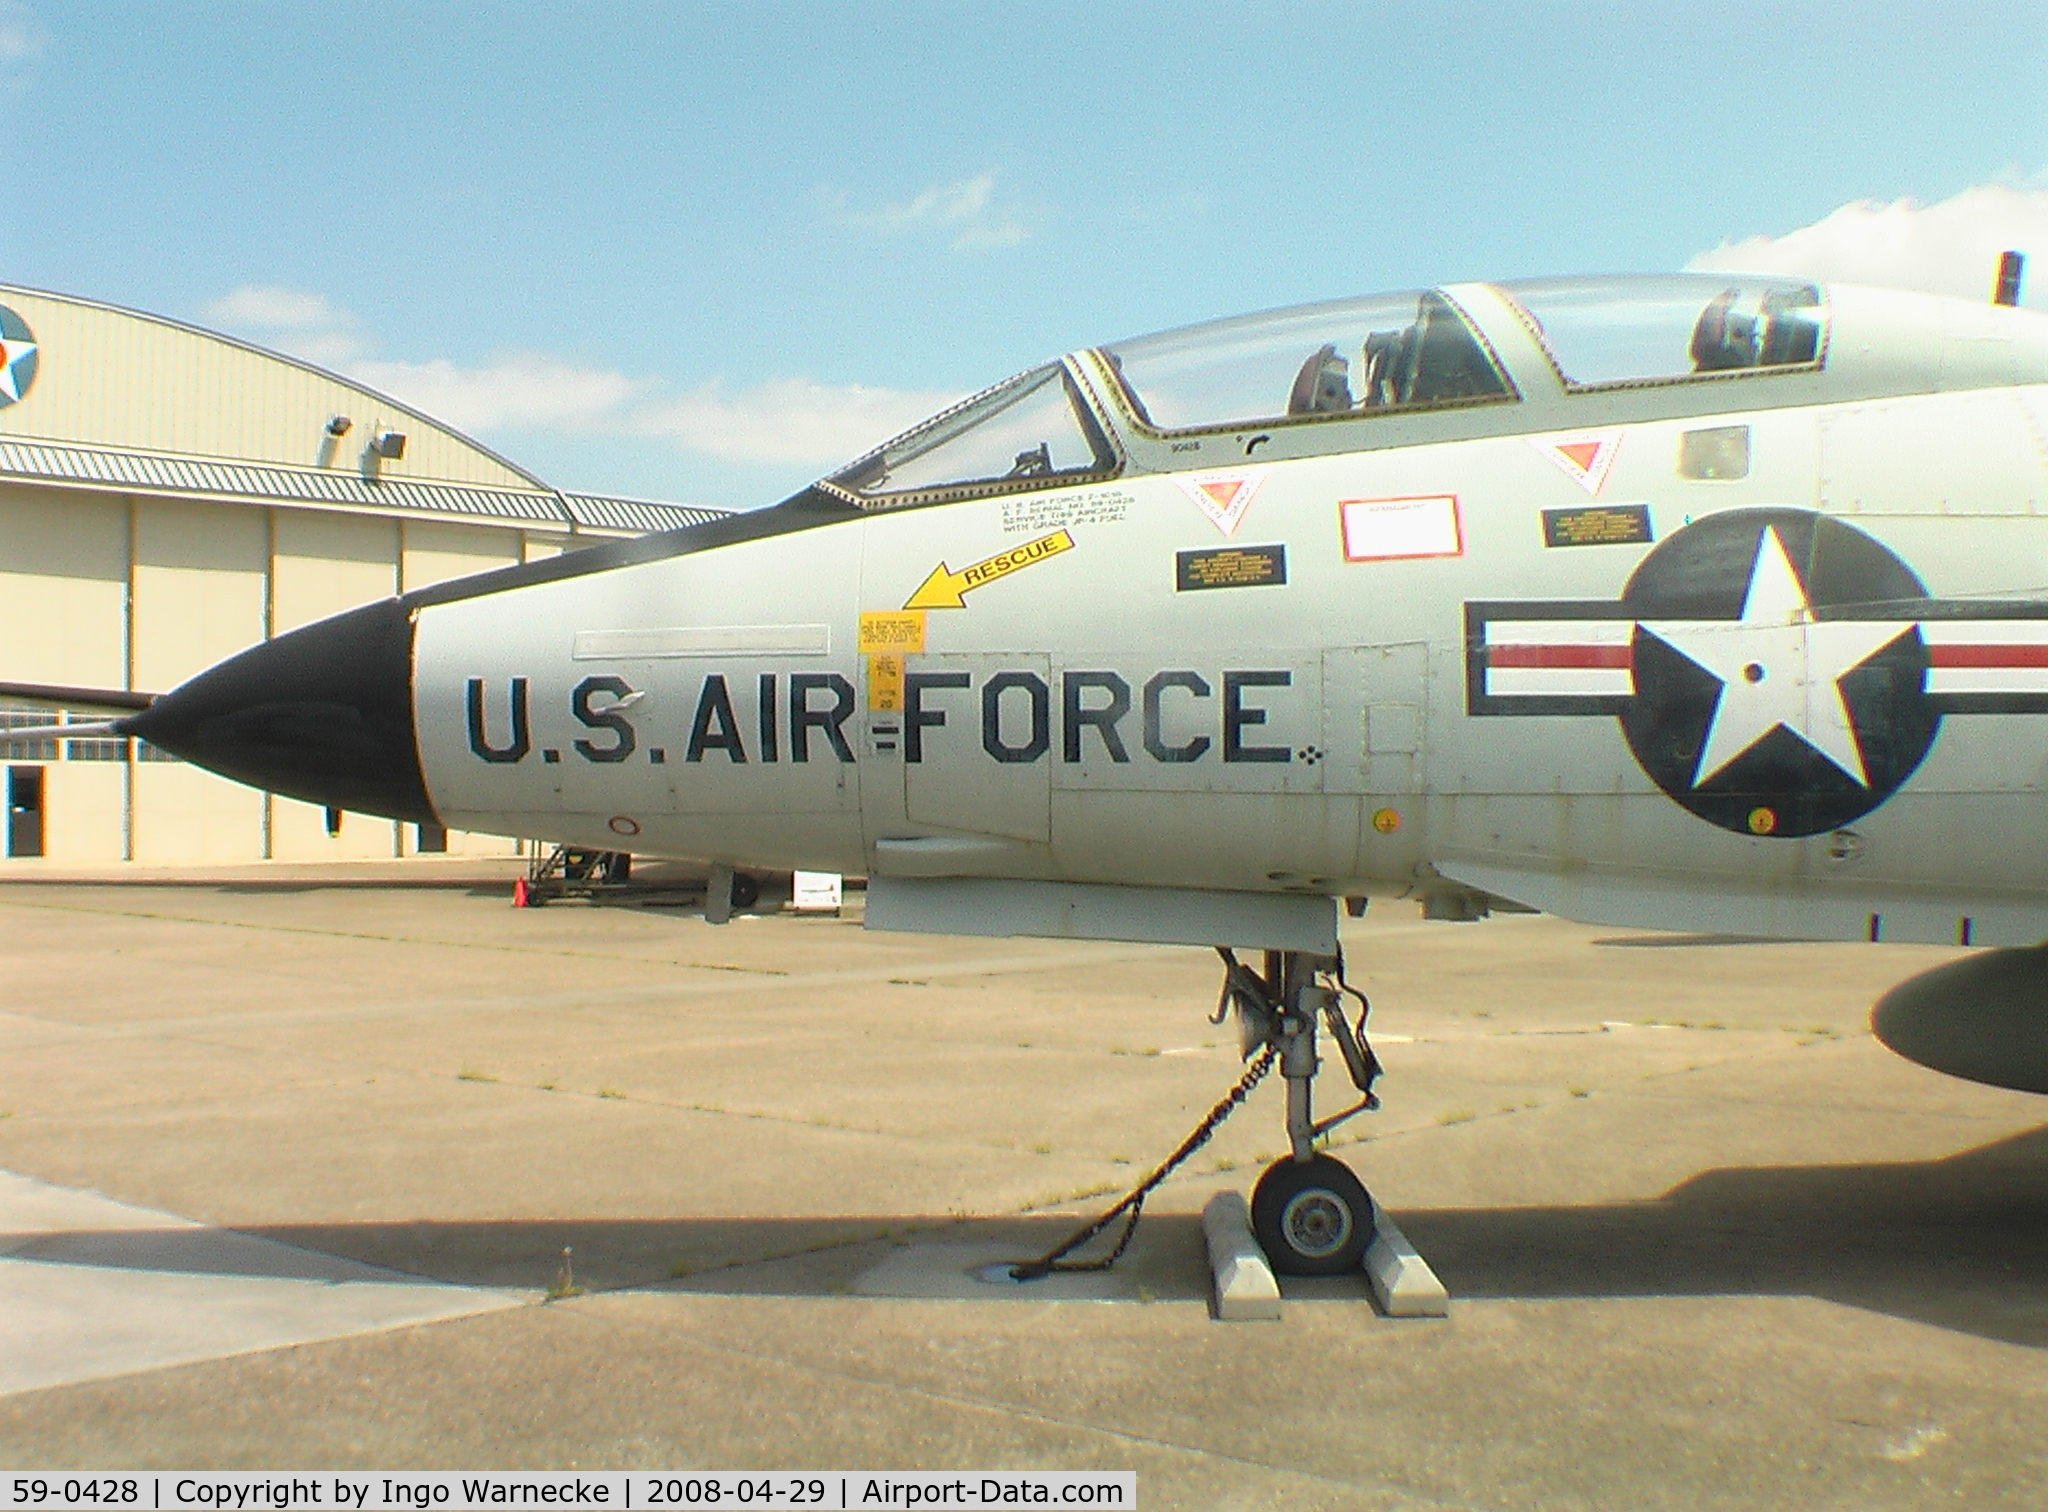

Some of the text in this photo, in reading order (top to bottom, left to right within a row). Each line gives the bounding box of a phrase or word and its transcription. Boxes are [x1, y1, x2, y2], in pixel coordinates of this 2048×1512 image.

[964, 537, 1059, 585] RESCUE
[465, 670, 1293, 764] U.S. AIR FORCE
